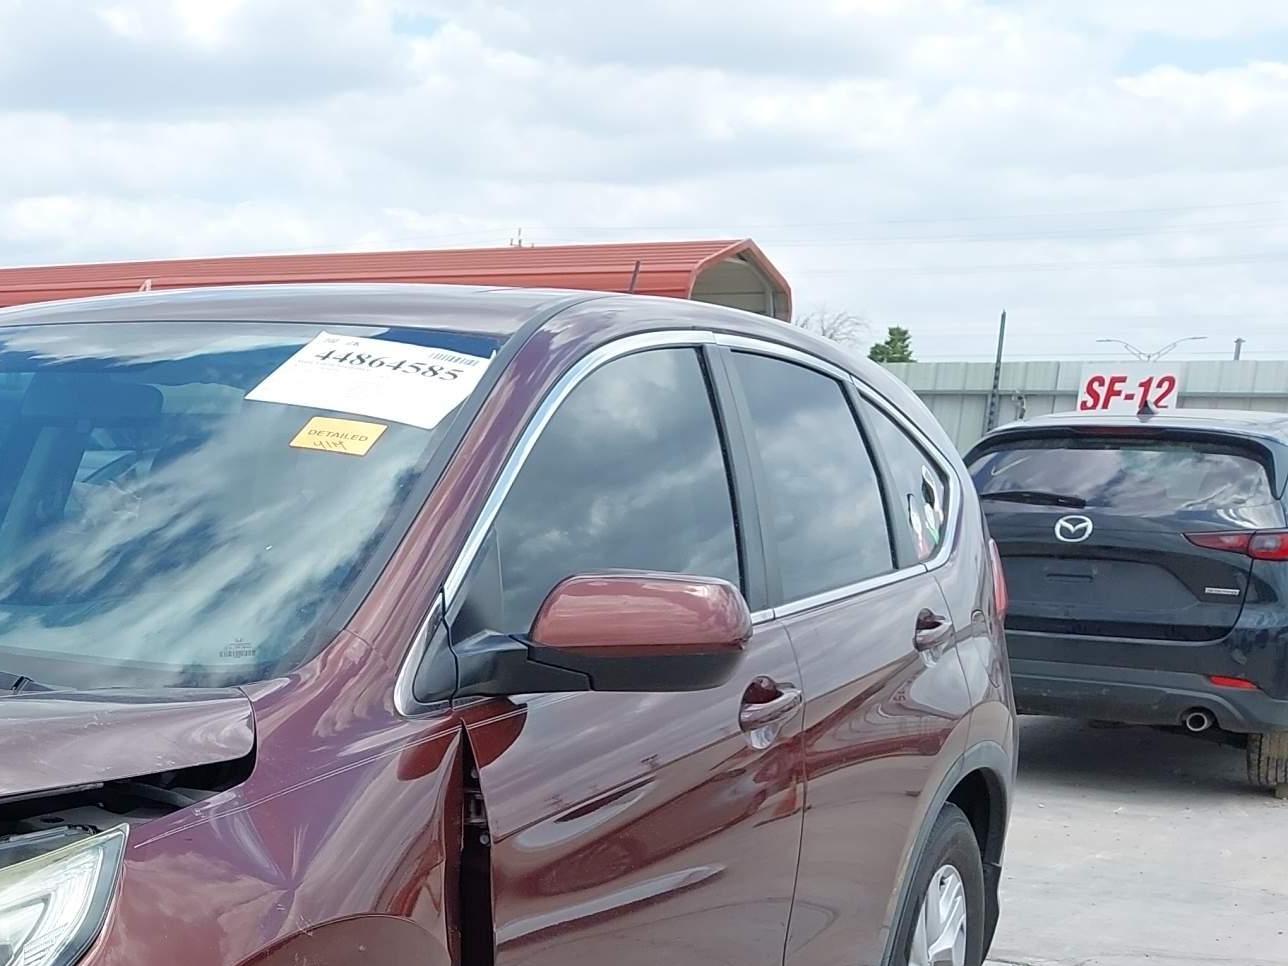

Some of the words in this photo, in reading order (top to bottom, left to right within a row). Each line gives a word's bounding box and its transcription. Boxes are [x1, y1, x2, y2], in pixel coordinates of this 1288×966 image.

[314, 349, 465, 381] 44864585
[1080, 375, 1177, 411] SF-12
[307, 429, 369, 442] DETAILED
